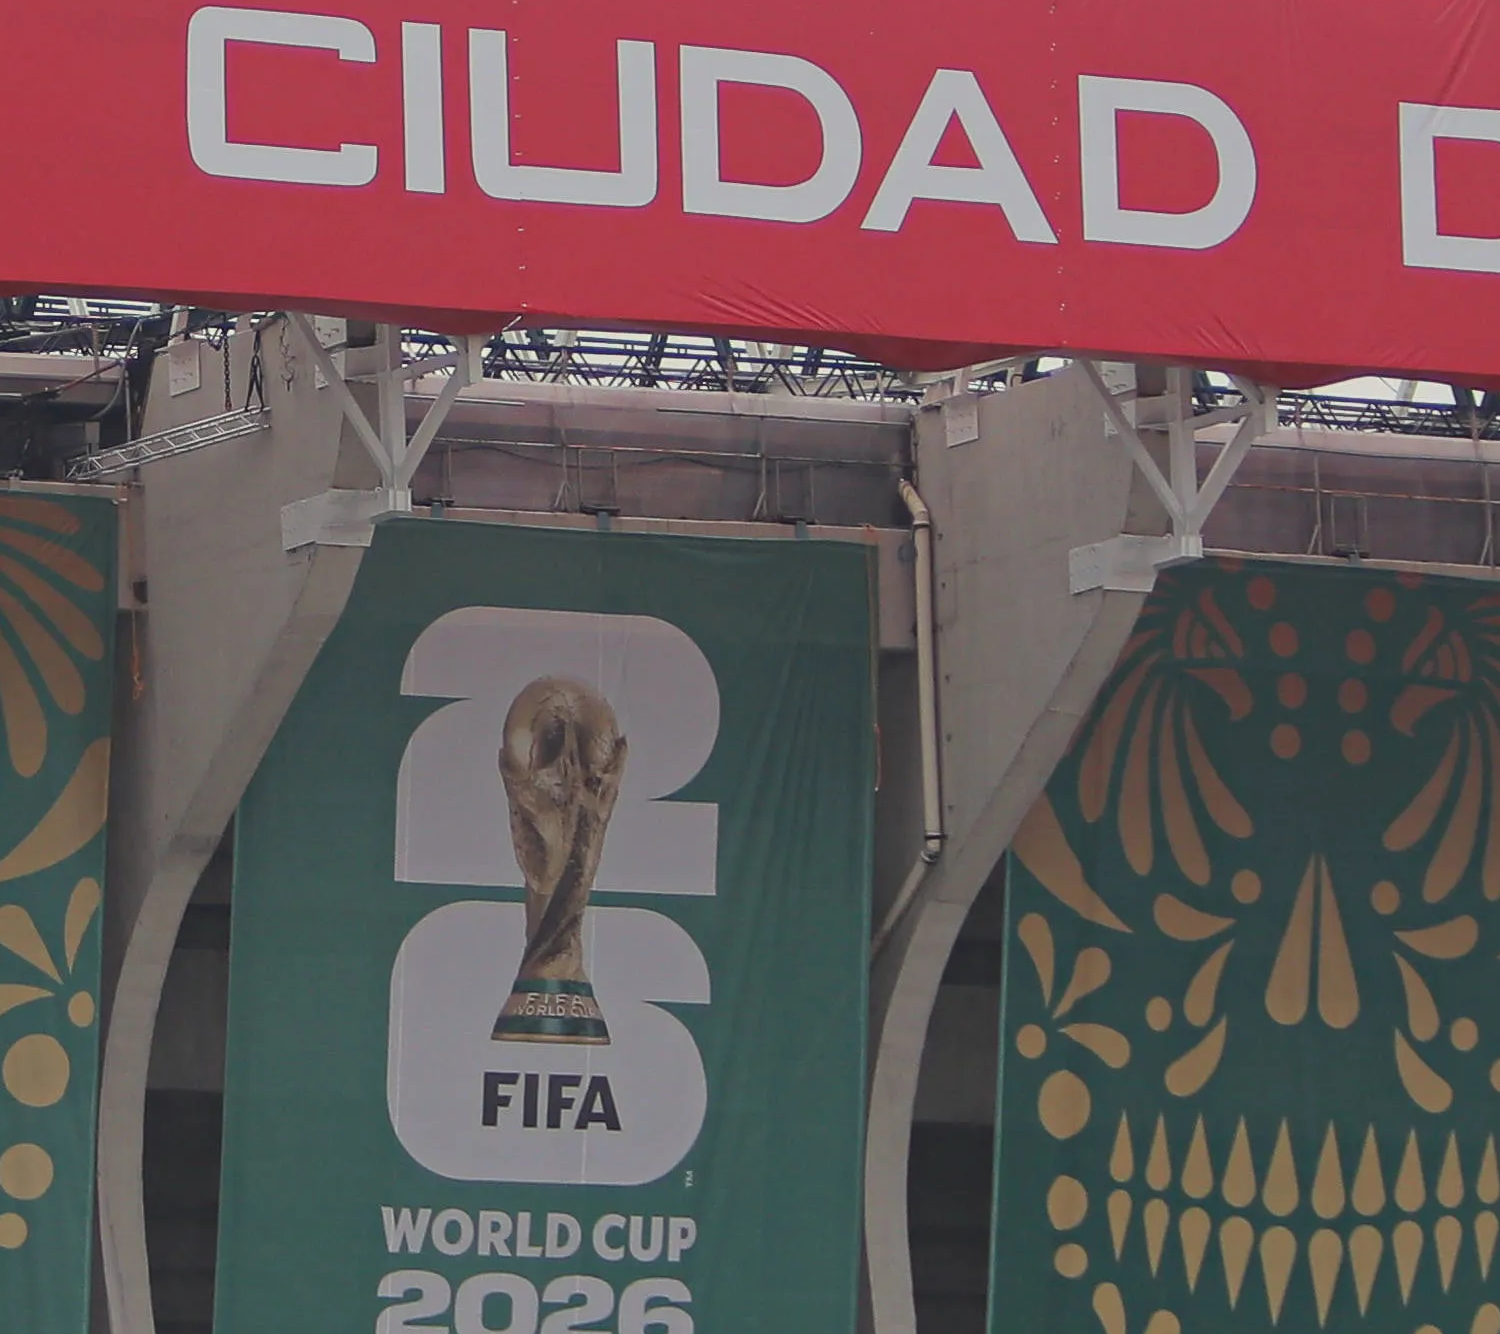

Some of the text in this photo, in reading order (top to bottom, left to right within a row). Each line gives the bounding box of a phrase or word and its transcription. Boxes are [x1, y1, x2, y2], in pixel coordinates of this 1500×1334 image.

[186, 5, 1257, 250] CIUDAD
[526, 992, 583, 1005] FIFA
[480, 1070, 623, 1133] FIFA
[380, 1205, 698, 1264] WORLD CUP
